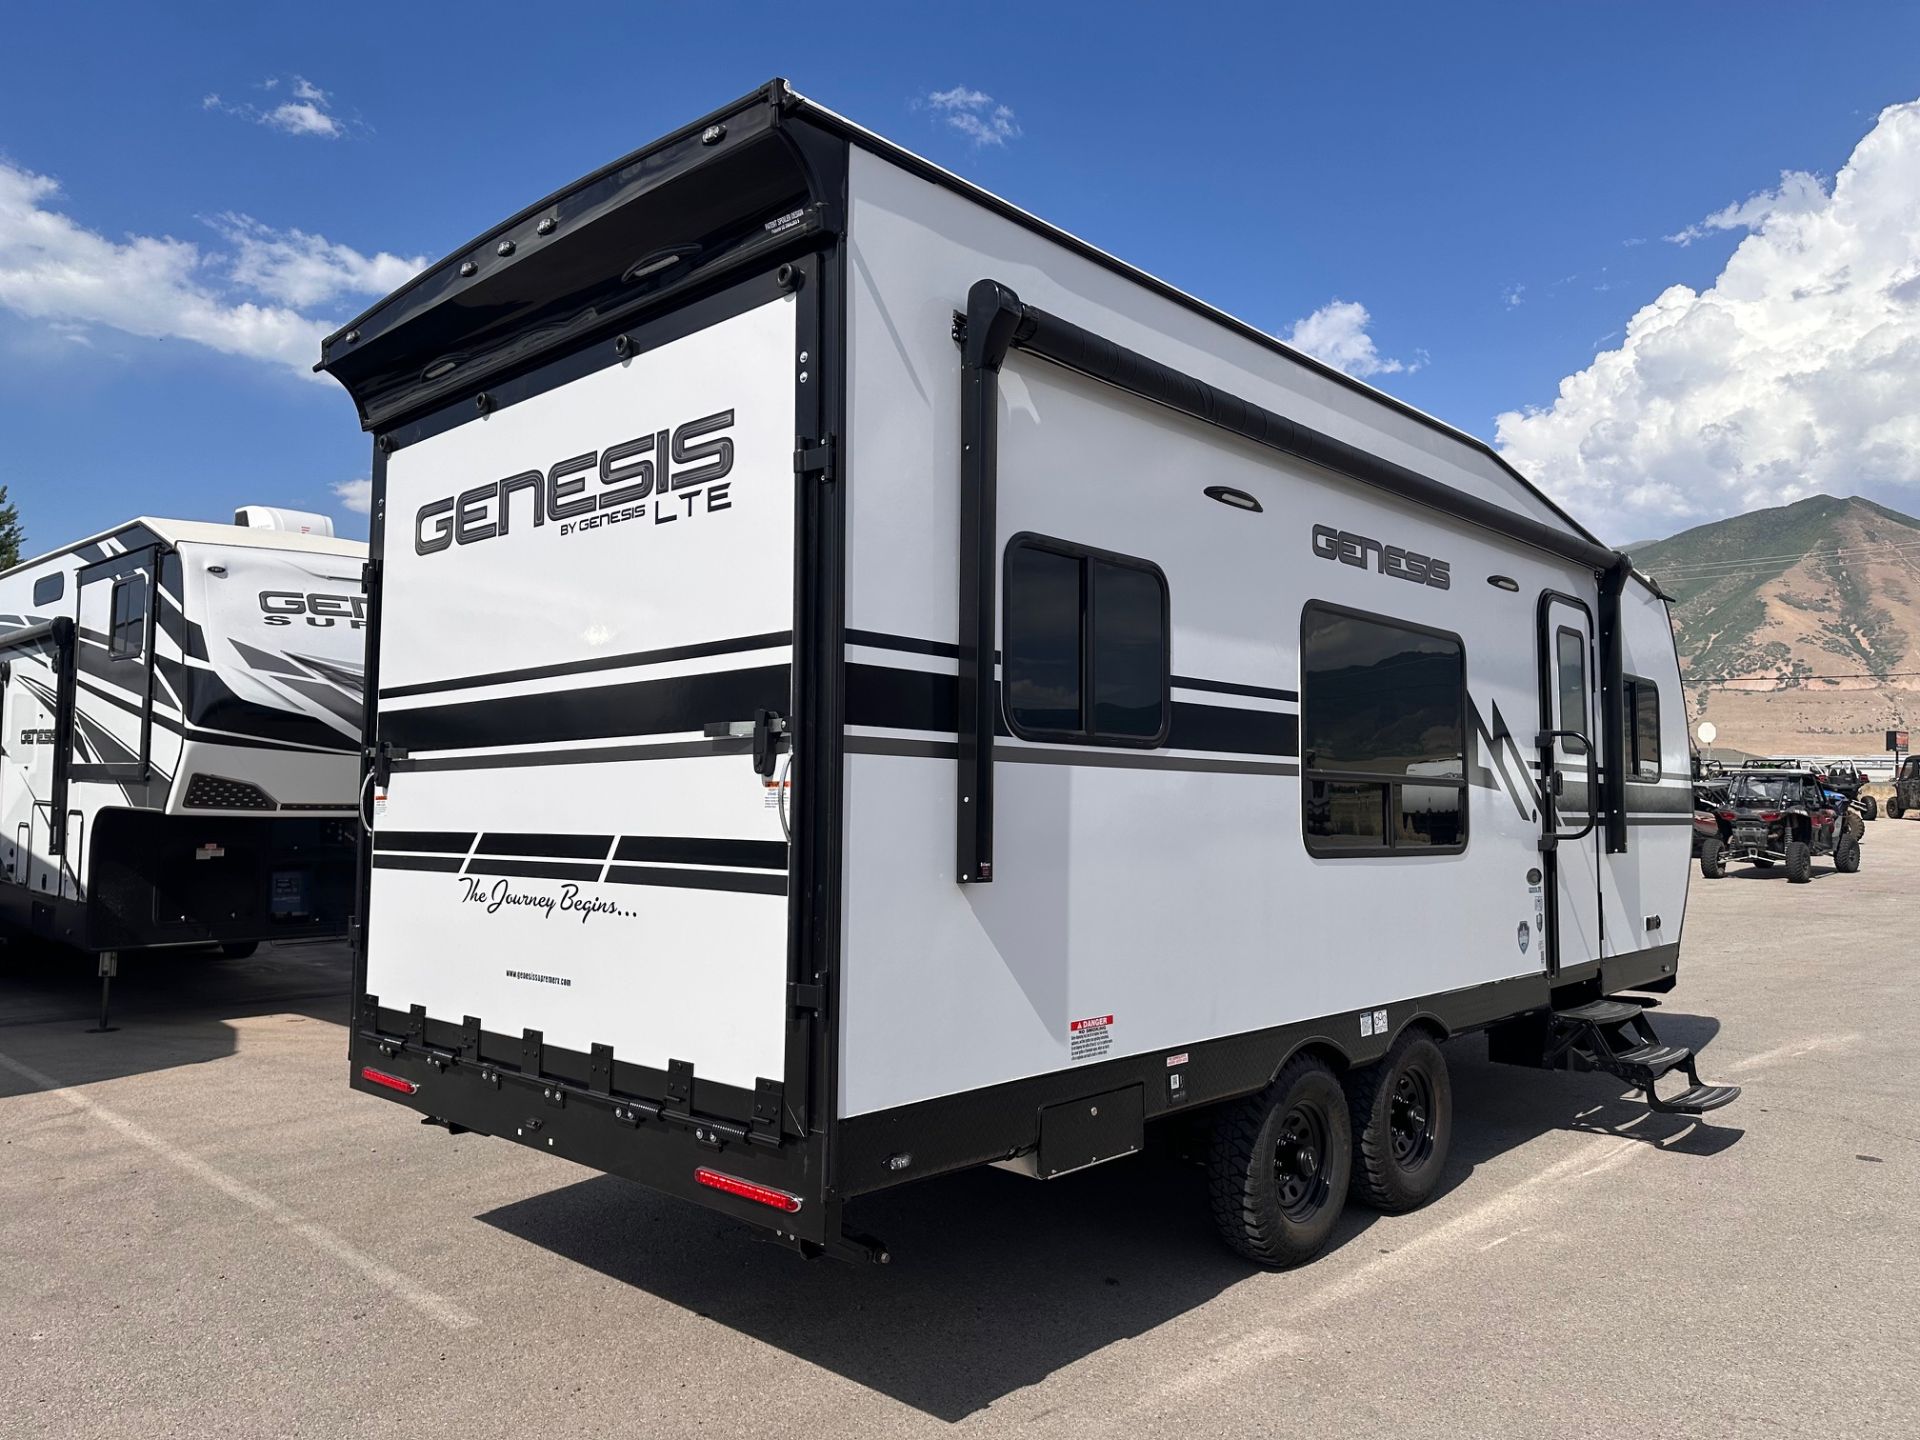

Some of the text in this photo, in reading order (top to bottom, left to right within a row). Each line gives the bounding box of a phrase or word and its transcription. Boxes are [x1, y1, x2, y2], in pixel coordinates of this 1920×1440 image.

[414, 408, 735, 557] GENESIS
[655, 482, 732, 525] LTE
[560, 504, 646, 536] BY GENESIS
[1312, 523, 1450, 591] GENESIS
[458, 877, 637, 924] The Journey Begins...
[1082, 1017, 1108, 1028] DANGER
